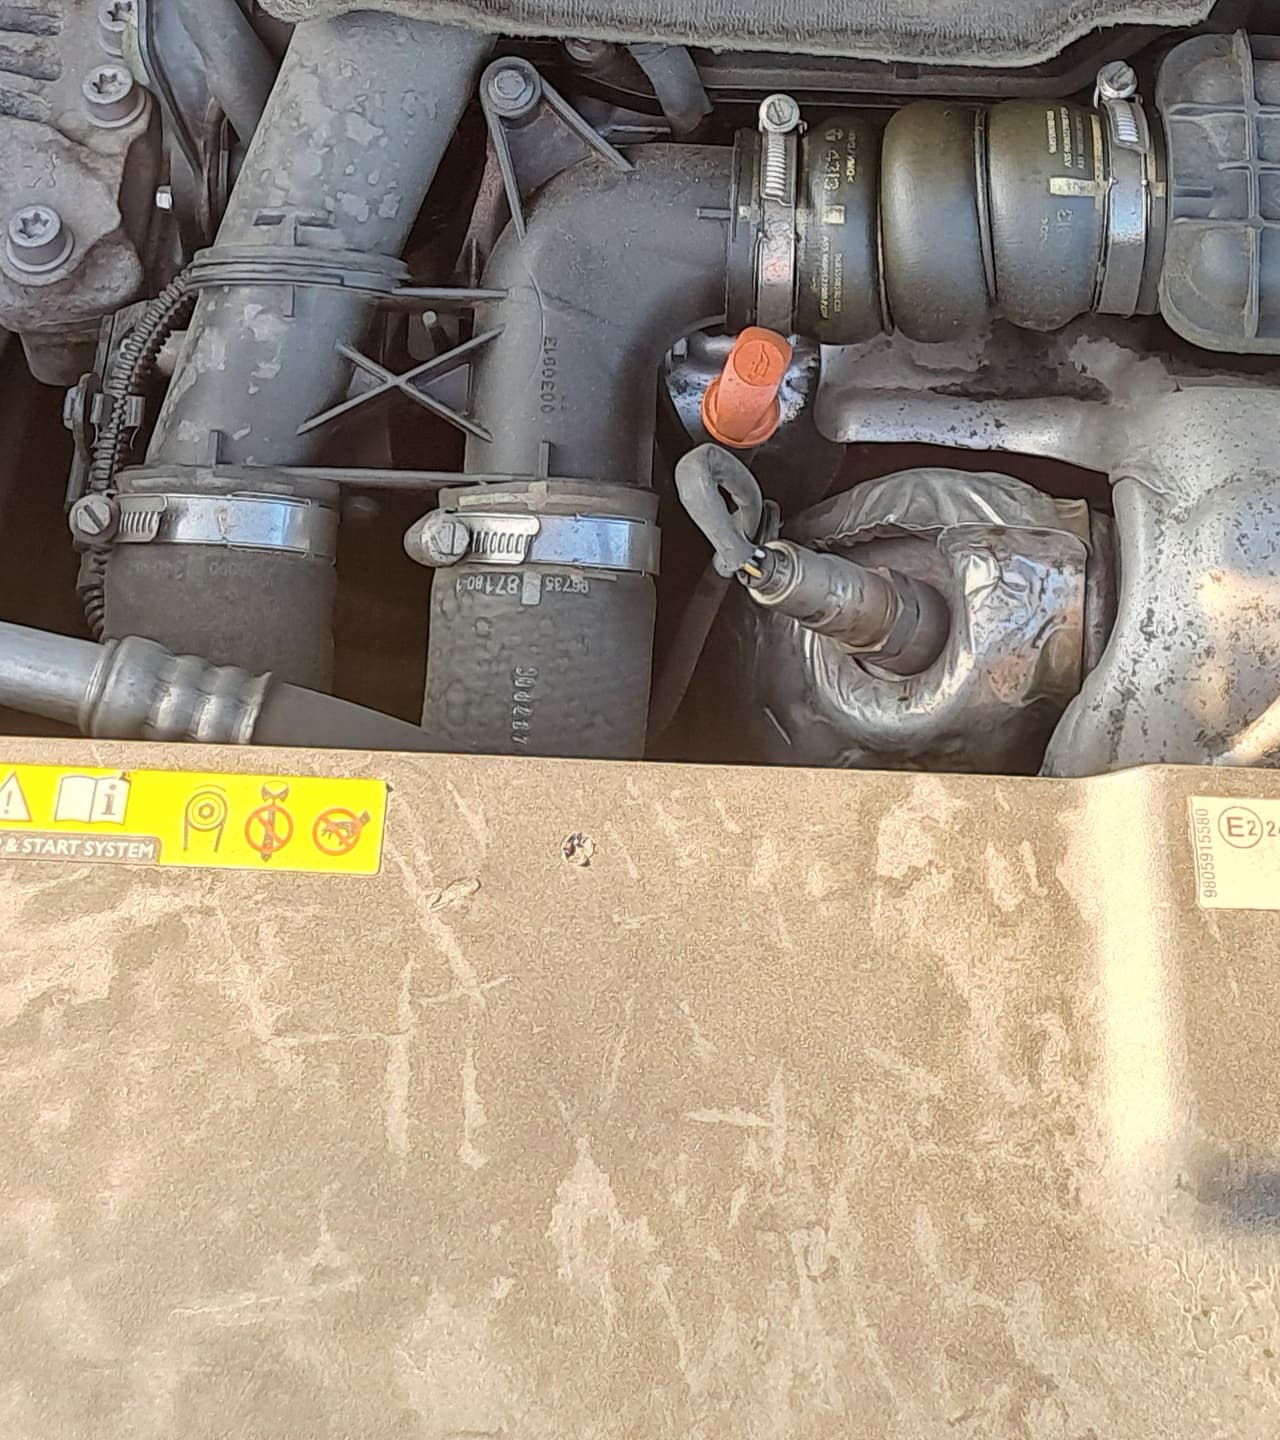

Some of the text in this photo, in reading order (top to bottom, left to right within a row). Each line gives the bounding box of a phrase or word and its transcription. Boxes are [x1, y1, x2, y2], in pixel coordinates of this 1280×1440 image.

[5, 838, 18, 852] &
[22, 838, 81, 855] START
[83, 840, 154, 859] SYSTEM
[1195, 808, 1217, 898] 9805915580
